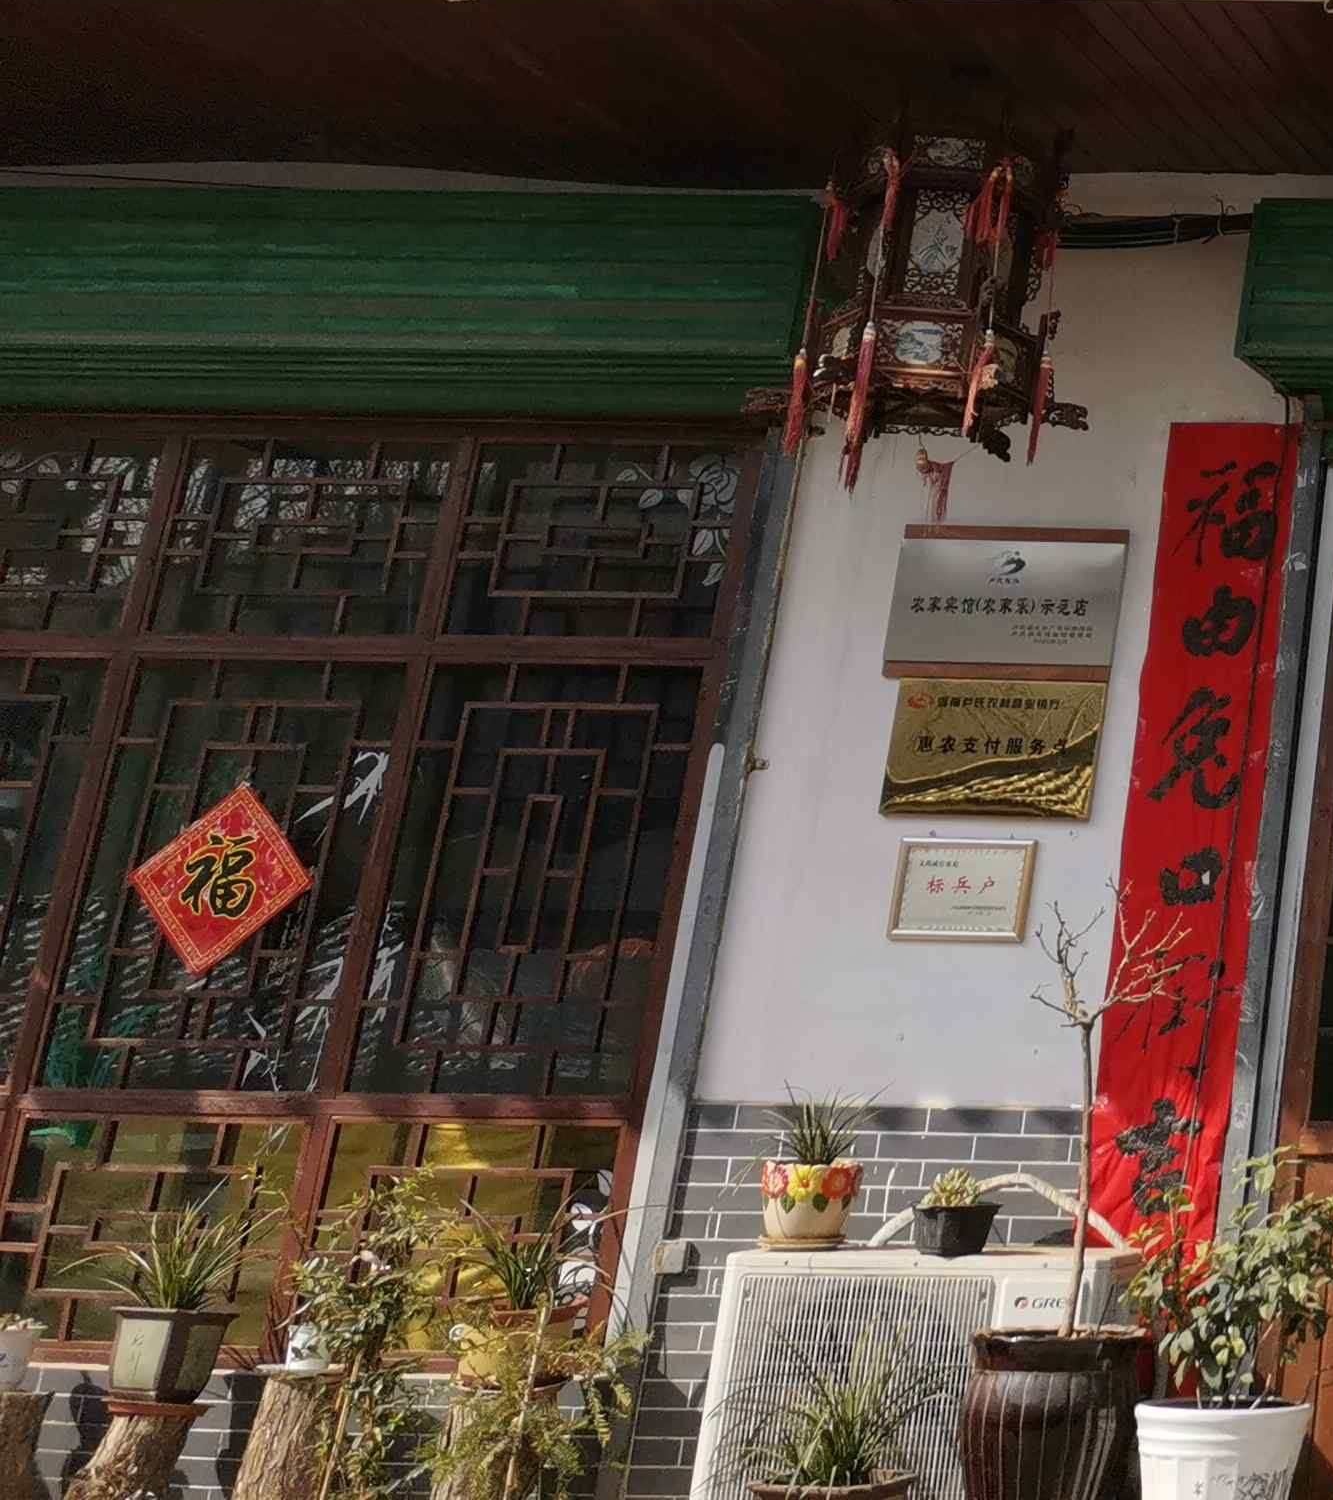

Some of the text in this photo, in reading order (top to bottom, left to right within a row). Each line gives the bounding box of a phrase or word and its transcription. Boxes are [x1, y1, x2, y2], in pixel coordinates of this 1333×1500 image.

[179, 831, 257, 919] 福
[927, 876, 995, 895] 标兵户
